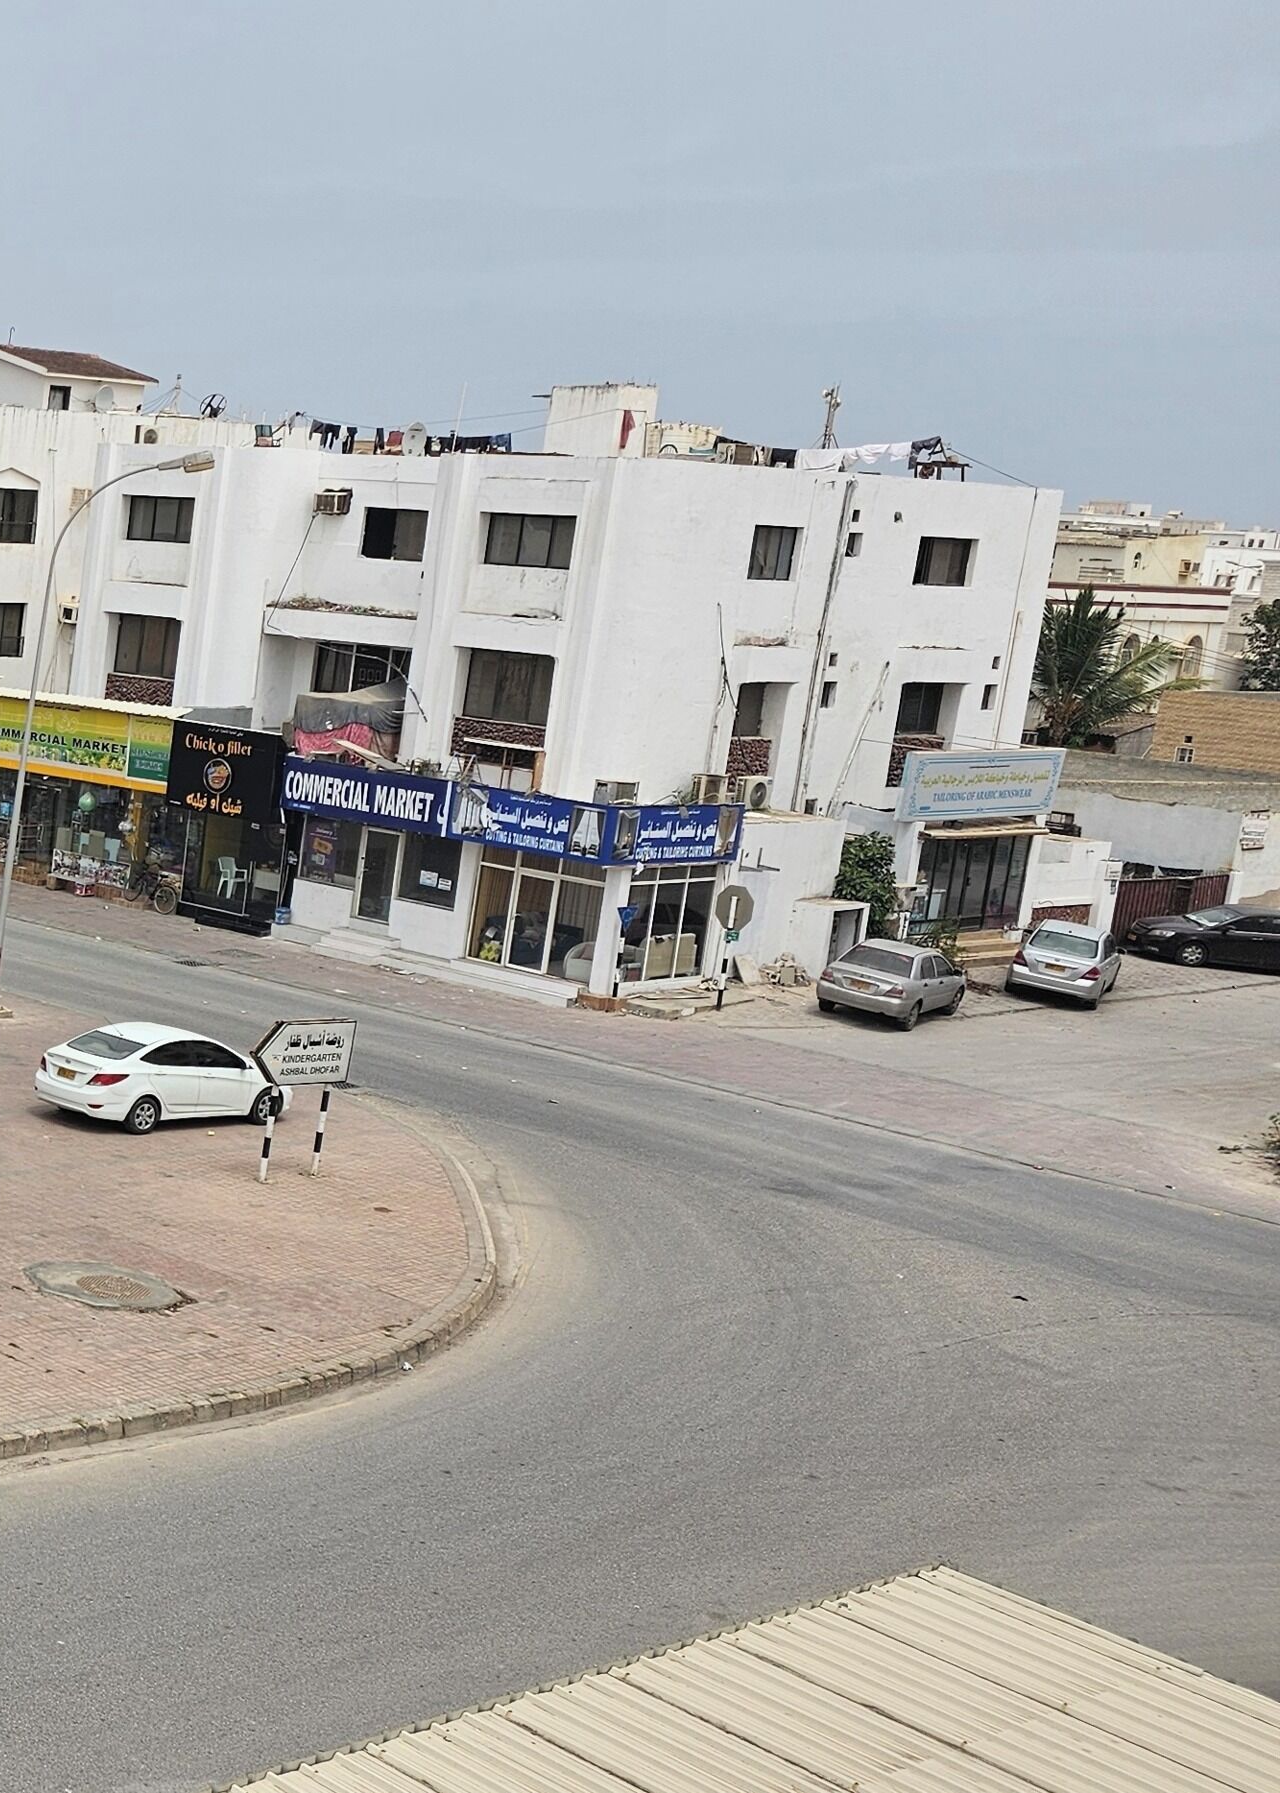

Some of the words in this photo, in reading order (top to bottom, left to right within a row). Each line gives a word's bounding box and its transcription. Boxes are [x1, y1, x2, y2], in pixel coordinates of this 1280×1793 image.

[72, 738, 127, 755] MARKET
[185, 733, 217, 755] Chick
[285, 770, 370, 812] COMMERCIAL
[373, 785, 434, 823] MARKET
[933, 790, 965, 802] TAILORING
[965, 790, 976, 801] OF
[976, 788, 997, 801] ARABIC
[997, 788, 1033, 800] MENSWEAR
[512, 833, 539, 849] TAILORING
[539, 838, 565, 854] CURTAINS
[284, 1033, 302, 1052] ظفار
[303, 1029, 326, 1051] أشبال
[326, 1032, 345, 1049] روضة
[282, 1052, 342, 1064] KINDERGARTEN
[280, 1066, 308, 1077] ASHBAL
[309, 1065, 340, 1075] DHOFAR
